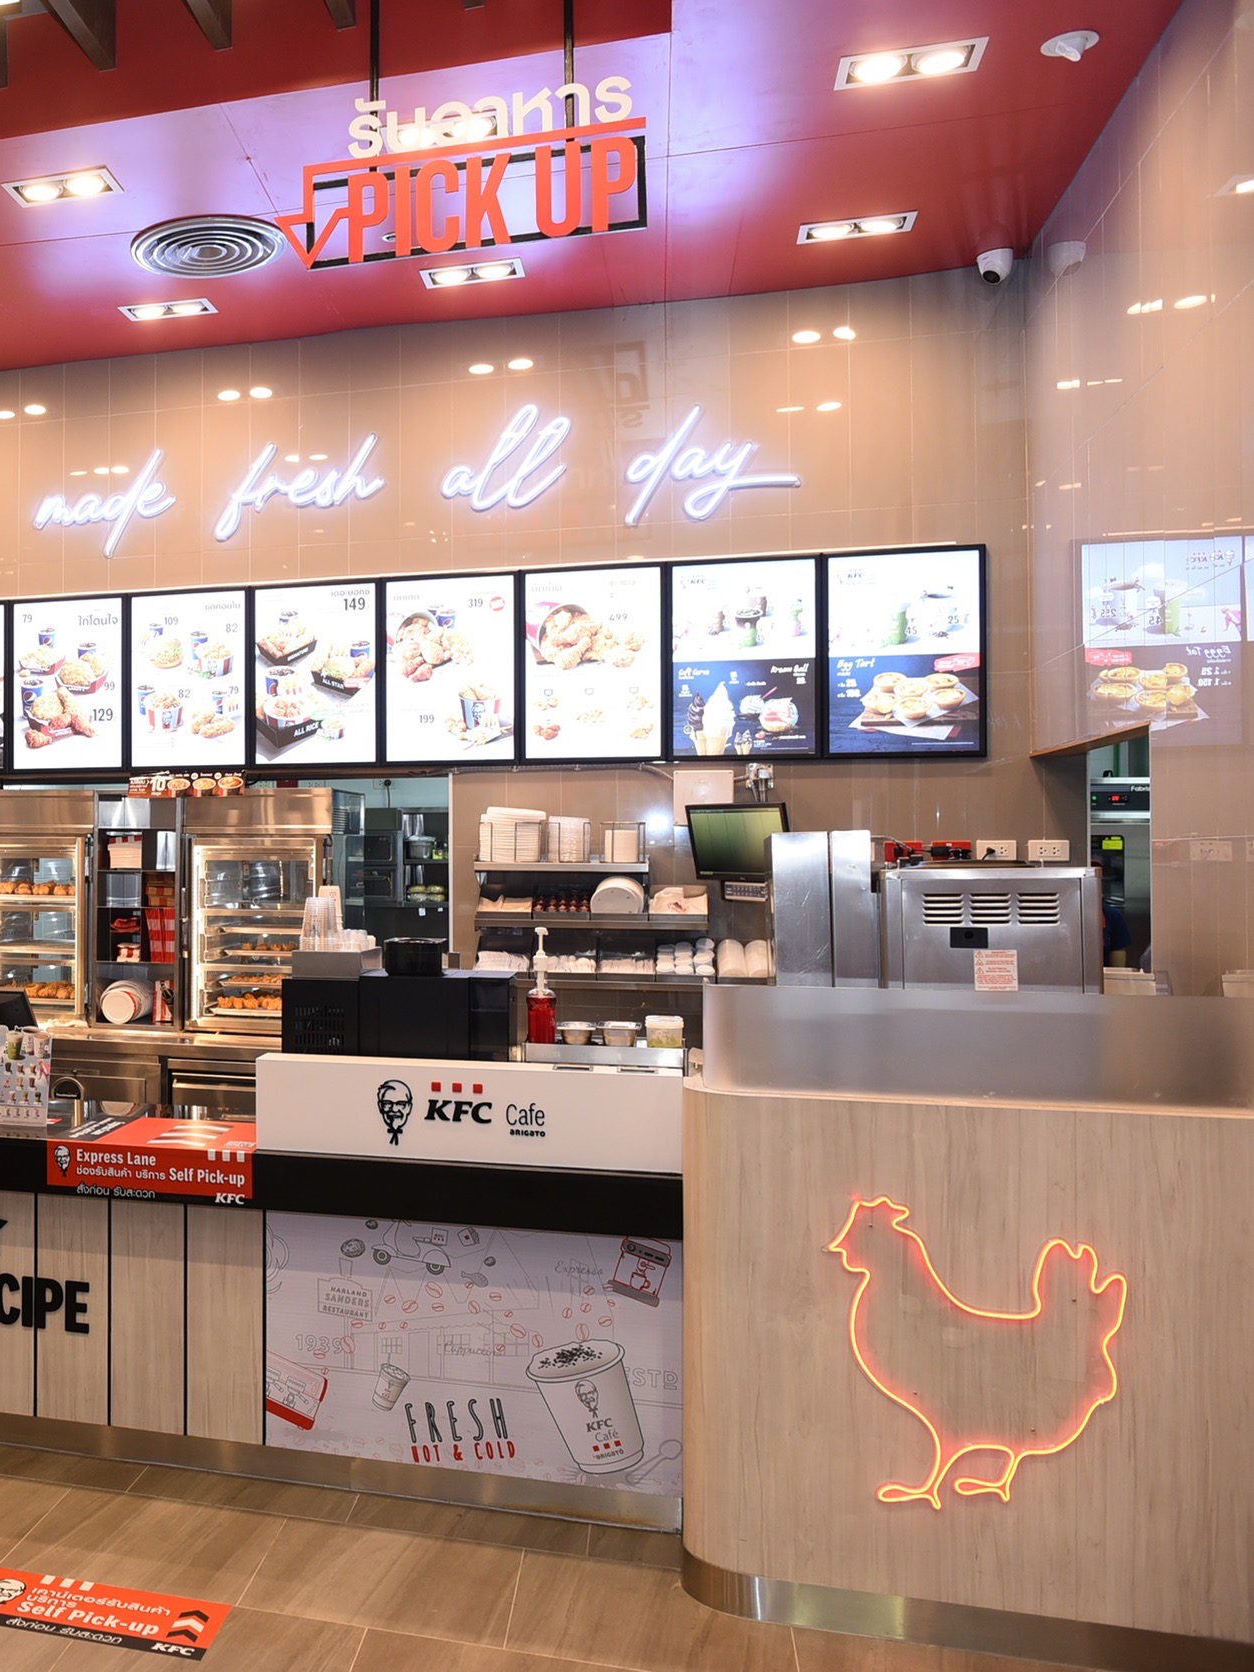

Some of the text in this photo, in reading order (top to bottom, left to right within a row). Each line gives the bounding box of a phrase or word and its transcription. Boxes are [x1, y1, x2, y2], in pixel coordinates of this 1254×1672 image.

[348, 76, 633, 159] รับอาหาร
[348, 136, 638, 264] PICK UP
[33, 404, 802, 558] made fresh all day
[343, 597, 366, 611] 149
[468, 598, 484, 608] 319
[22, 613, 33, 623] 79
[164, 616, 179, 626] 109
[609, 613, 628, 622] 499
[225, 623, 238, 633] 82
[103, 681, 116, 691] 99
[229, 686, 239, 695] 79
[178, 688, 191, 699] 82
[92, 708, 114, 722] 129
[419, 714, 435, 724] 199
[294, 721, 320, 737] ALL RICE
[424, 1099, 545, 1126] KFC Cafe
[76, 1148, 156, 1166] Express Lane
[76, 1165, 245, 1187] ช่องรับสินค้า บริการ Self Pick-up
[76, 1180, 156, 1199] สั่งก่อน รับสะดวก
[215, 1192, 245, 1205] KFC
[330, 1286, 368, 1297] HARLAND
[325, 1293, 370, 1308] SANDERS
[322, 1305, 369, 1319] RESTAURANT
[295, 1333, 343, 1355] 1939
[404, 1398, 509, 1443] FRESH
[586, 1418, 614, 1433] KFC
[595, 1429, 620, 1443] Café
[453, 1443, 464, 1461] &
[473, 1440, 516, 1461] COLD
[31, 1586, 171, 1616] เคาน์เตอร์รับสินค้า
[16, 1600, 160, 1637] Self Pick-up
[151, 1642, 196, 1656] KFC
